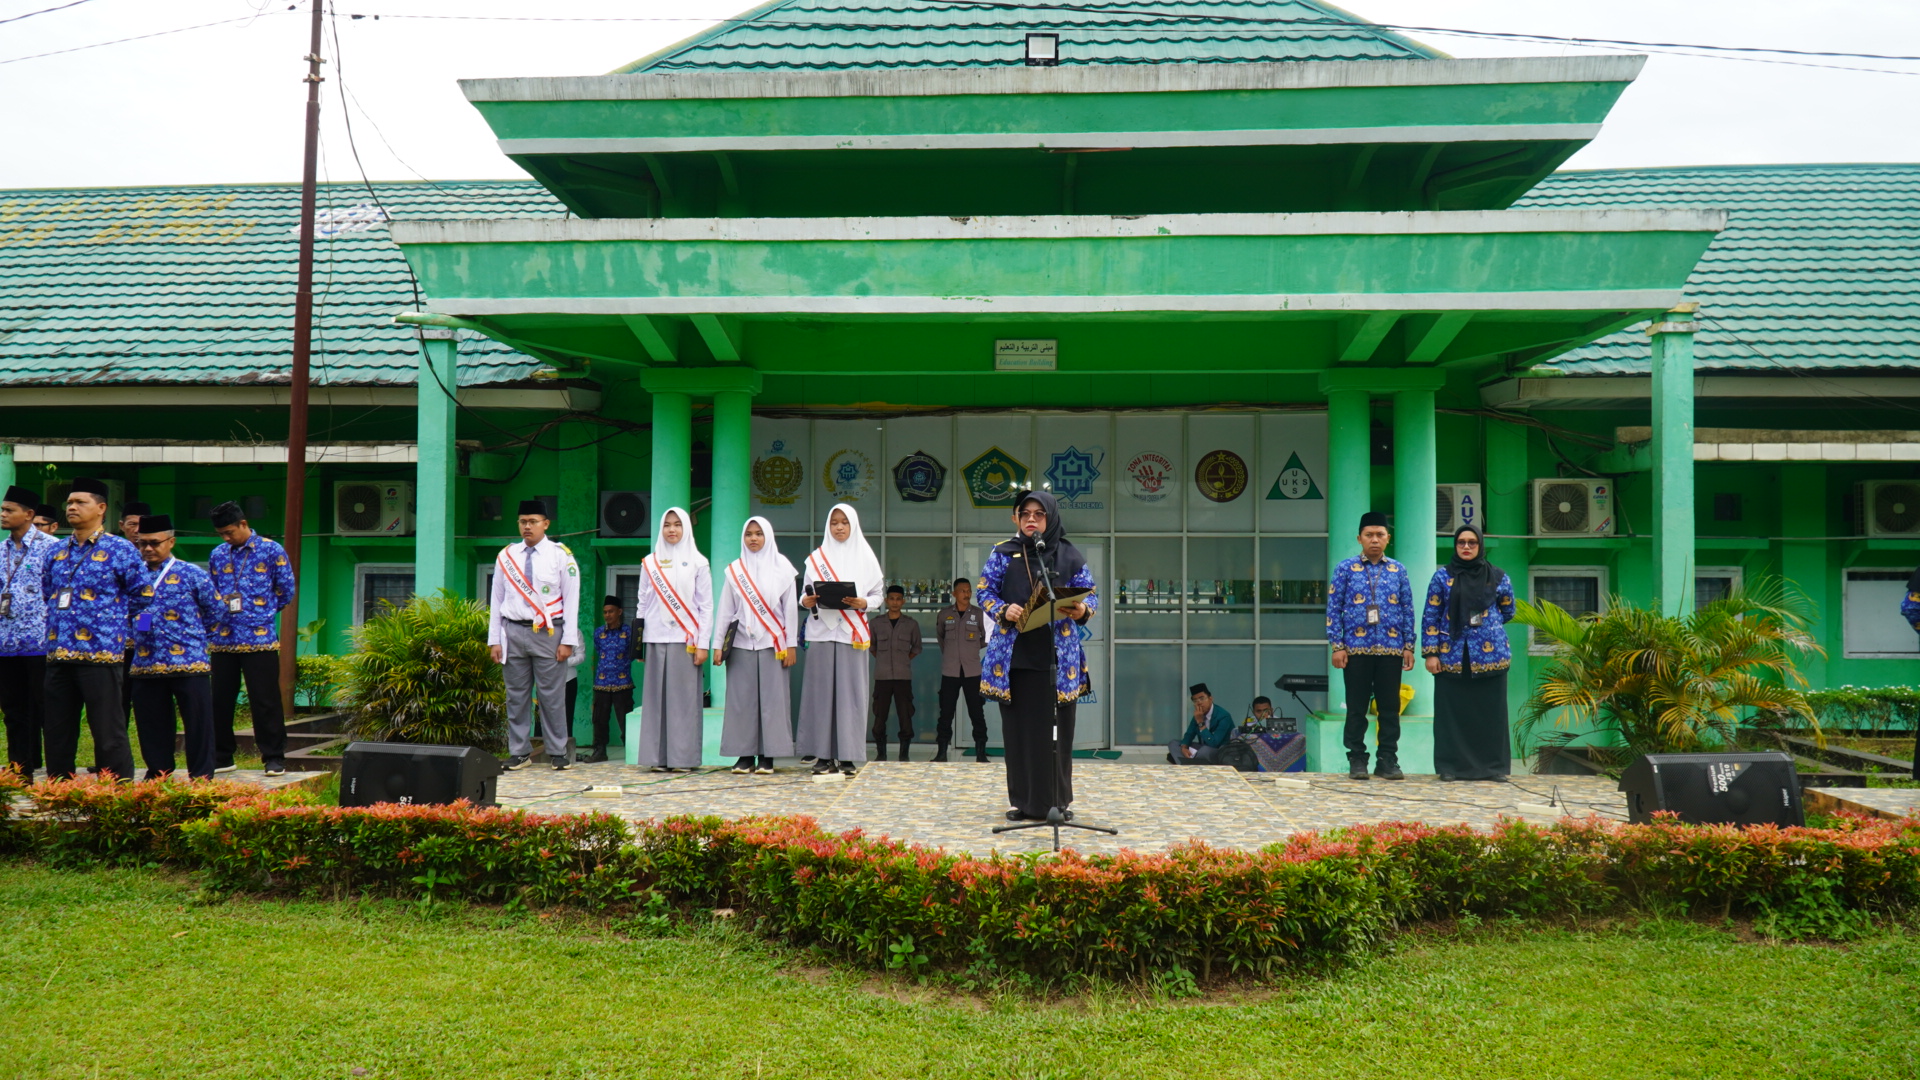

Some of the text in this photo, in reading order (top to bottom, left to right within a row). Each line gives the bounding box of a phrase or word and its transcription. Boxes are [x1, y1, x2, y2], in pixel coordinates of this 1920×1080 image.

[999, 358, 1054, 367] Education Building
[1127, 454, 1173, 473] ZONA INTEGRITAS
[1145, 479, 1158, 488] NO
[1068, 501, 1104, 510] CENDEKIA
[504, 559, 522, 585] PEMBACA
[819, 563, 833, 582] PEMBA
[651, 569, 669, 596] PEMBACA
[665, 593, 681, 612] IKRAR
[738, 573, 768, 616] PEMBACA UUD 1945
[1711, 765, 1719, 793] Premium
[1719, 773, 1728, 792] 500
[1724, 764, 1733, 782] JS10
